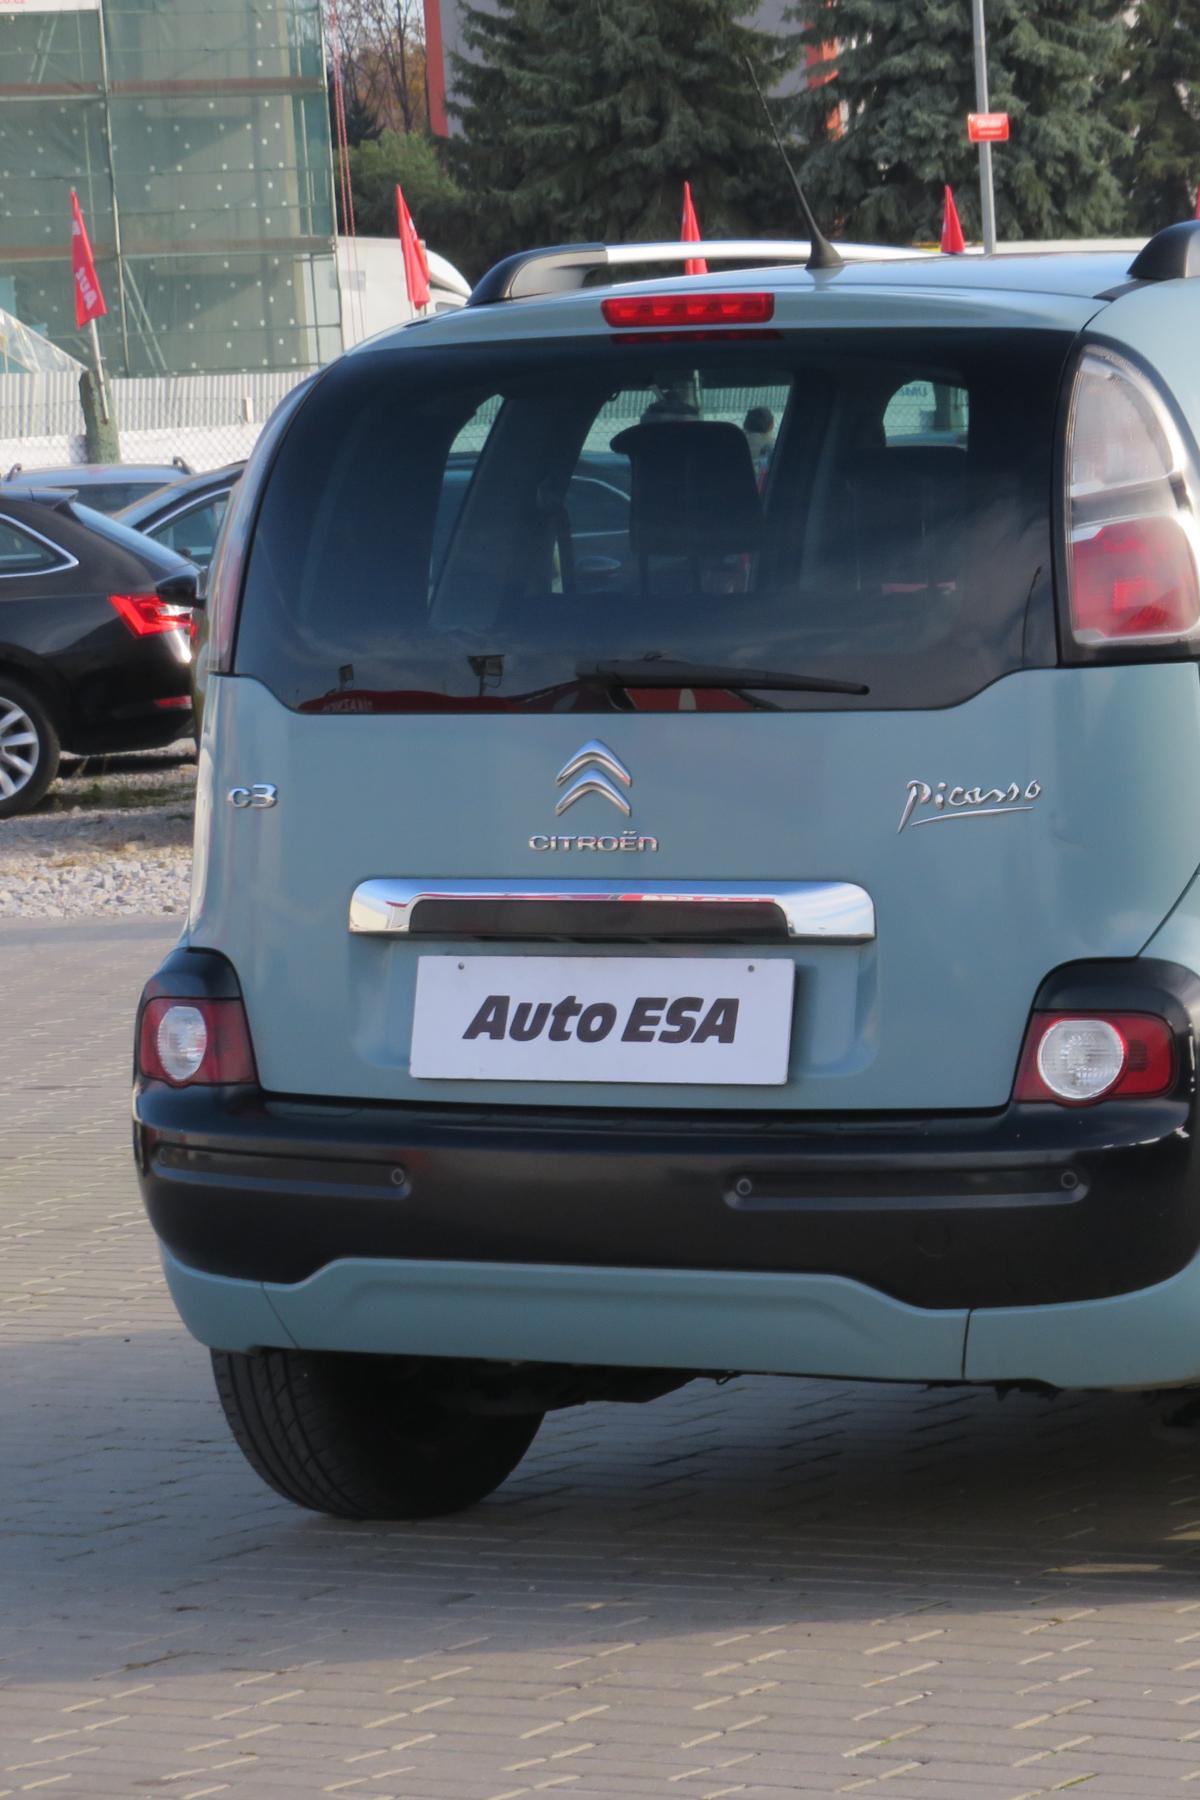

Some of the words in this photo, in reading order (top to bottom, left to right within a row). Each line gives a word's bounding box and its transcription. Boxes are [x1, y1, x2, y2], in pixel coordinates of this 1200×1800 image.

[227, 783, 278, 808] C3
[897, 779, 1042, 833] Picasso
[462, 995, 617, 1043] Auto
[621, 996, 740, 1044] ESA
